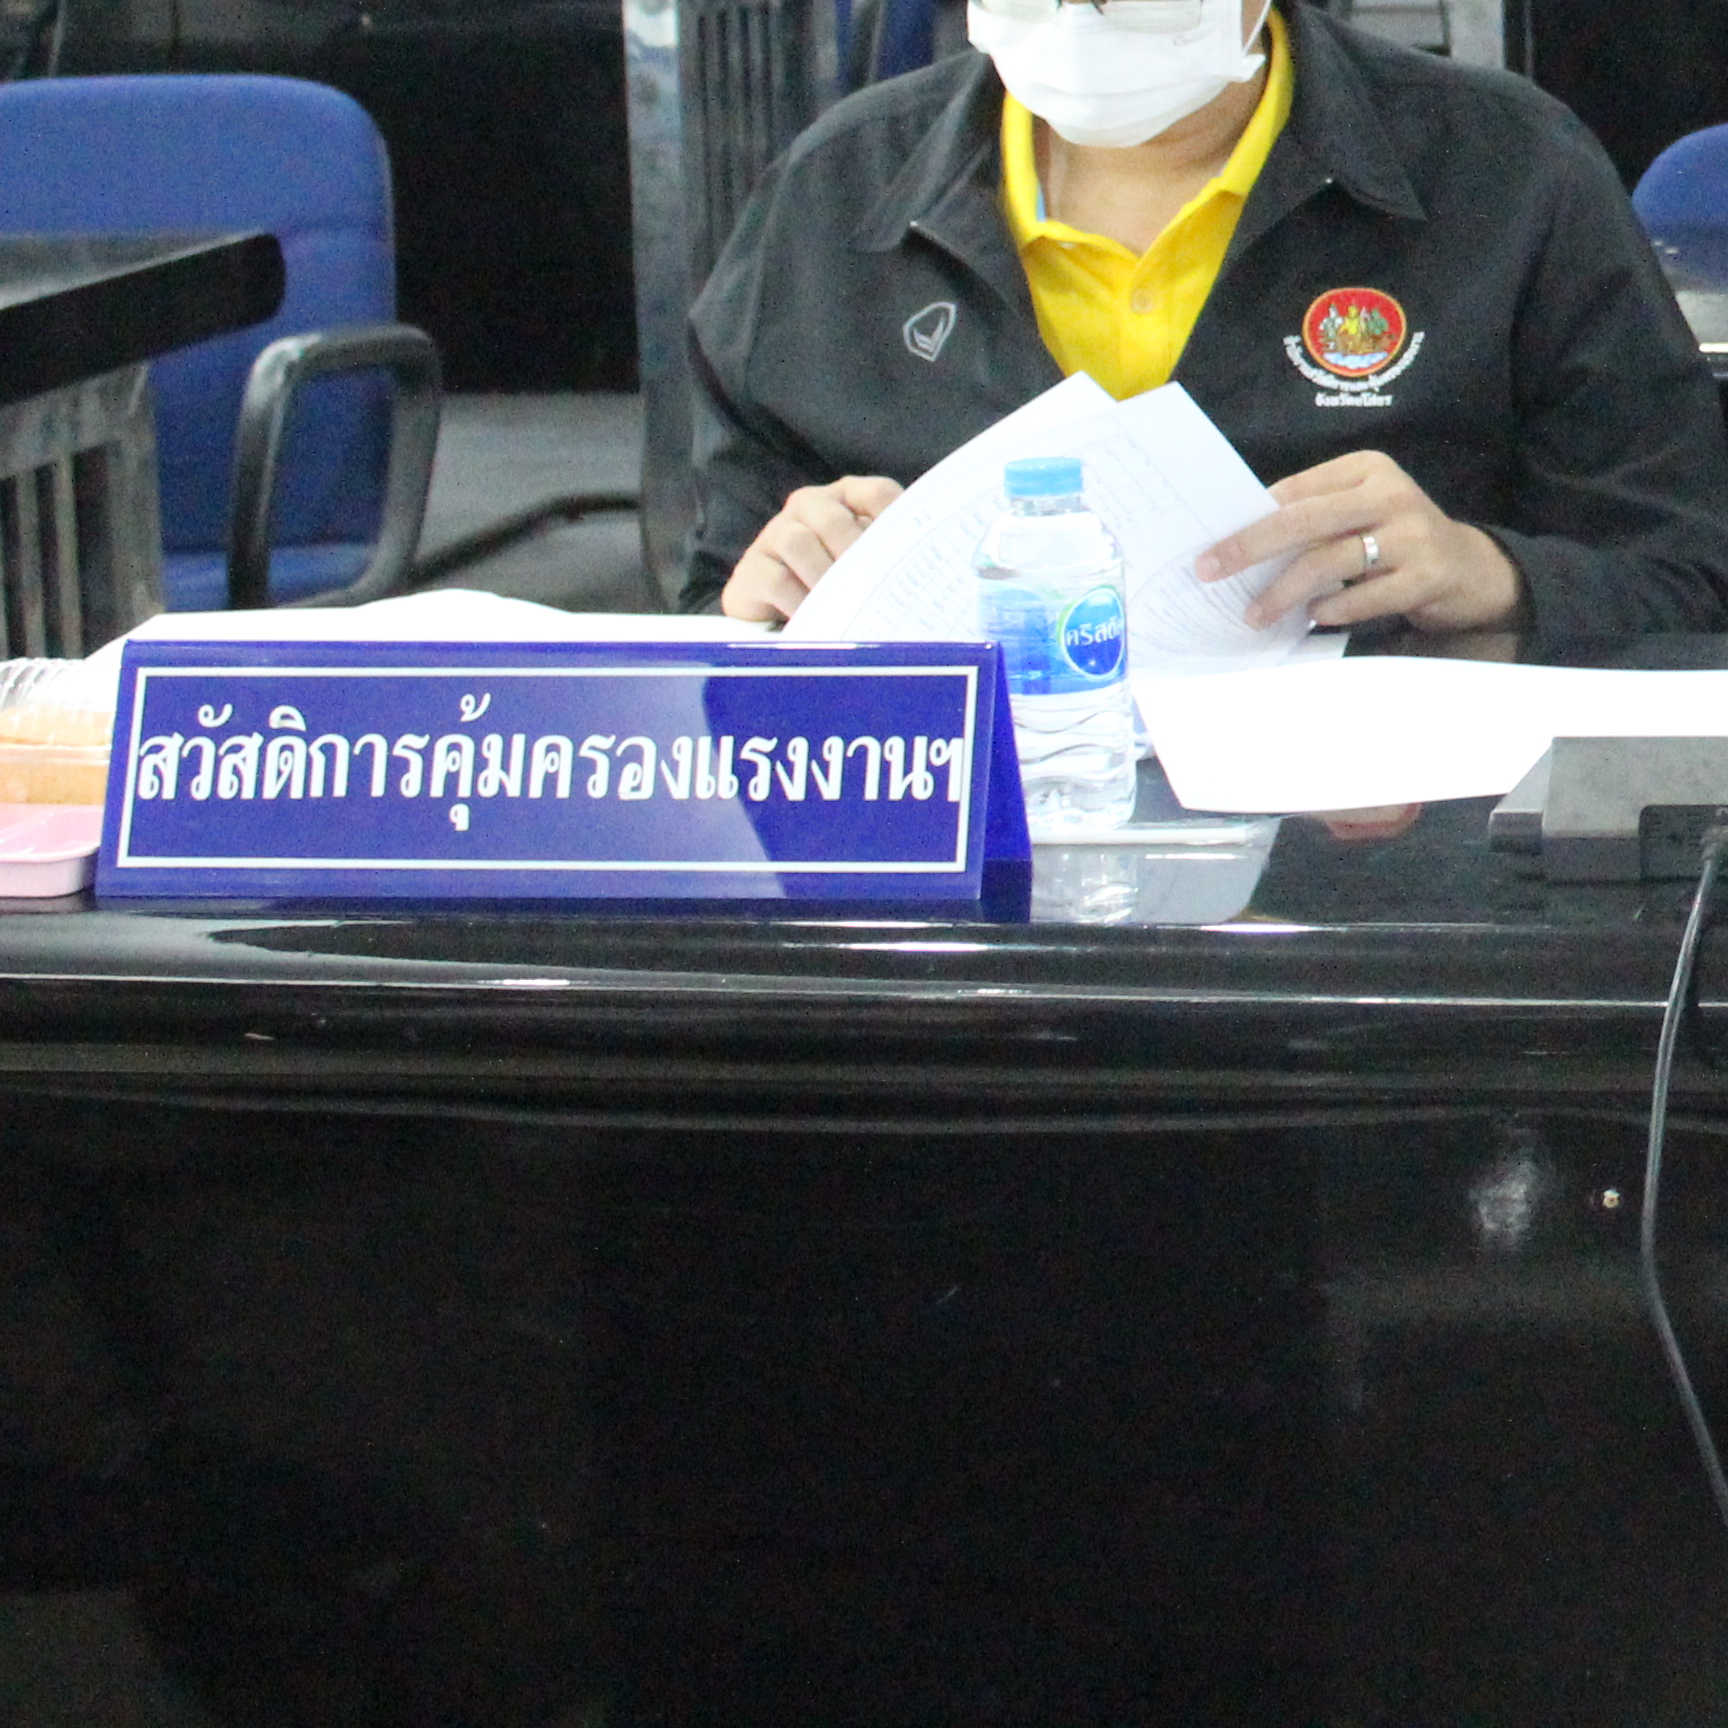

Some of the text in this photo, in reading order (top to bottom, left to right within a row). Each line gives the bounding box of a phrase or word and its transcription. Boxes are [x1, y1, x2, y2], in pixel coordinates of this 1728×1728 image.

[137, 691, 965, 832] สวัสดิการคุ้มครองแรงงานฯ
